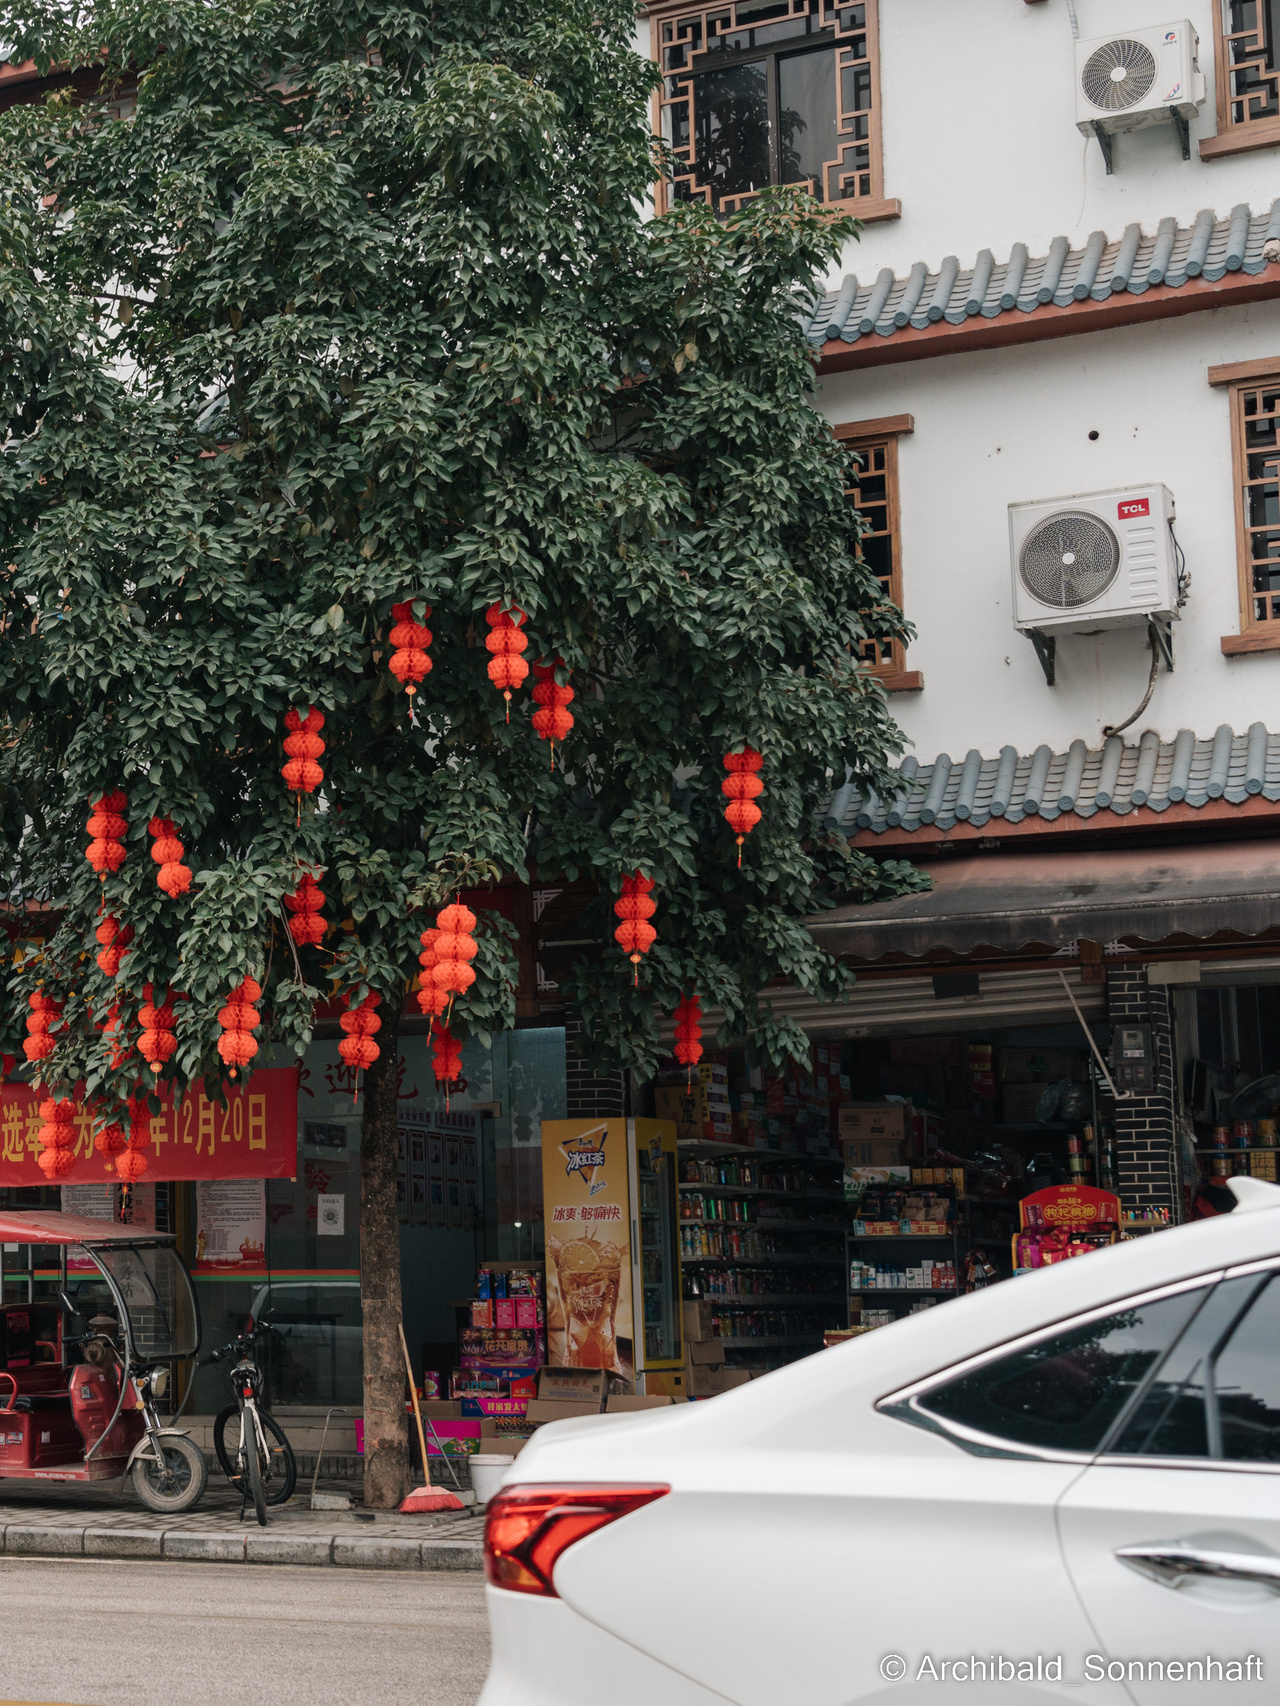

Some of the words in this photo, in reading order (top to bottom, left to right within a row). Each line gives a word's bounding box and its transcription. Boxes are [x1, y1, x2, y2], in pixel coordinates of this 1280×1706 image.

[1122, 504, 1146, 514] TCL
[566, 1151, 604, 1171] 冰红茶
[553, 1205, 621, 1221] 冰爽·够痛快
